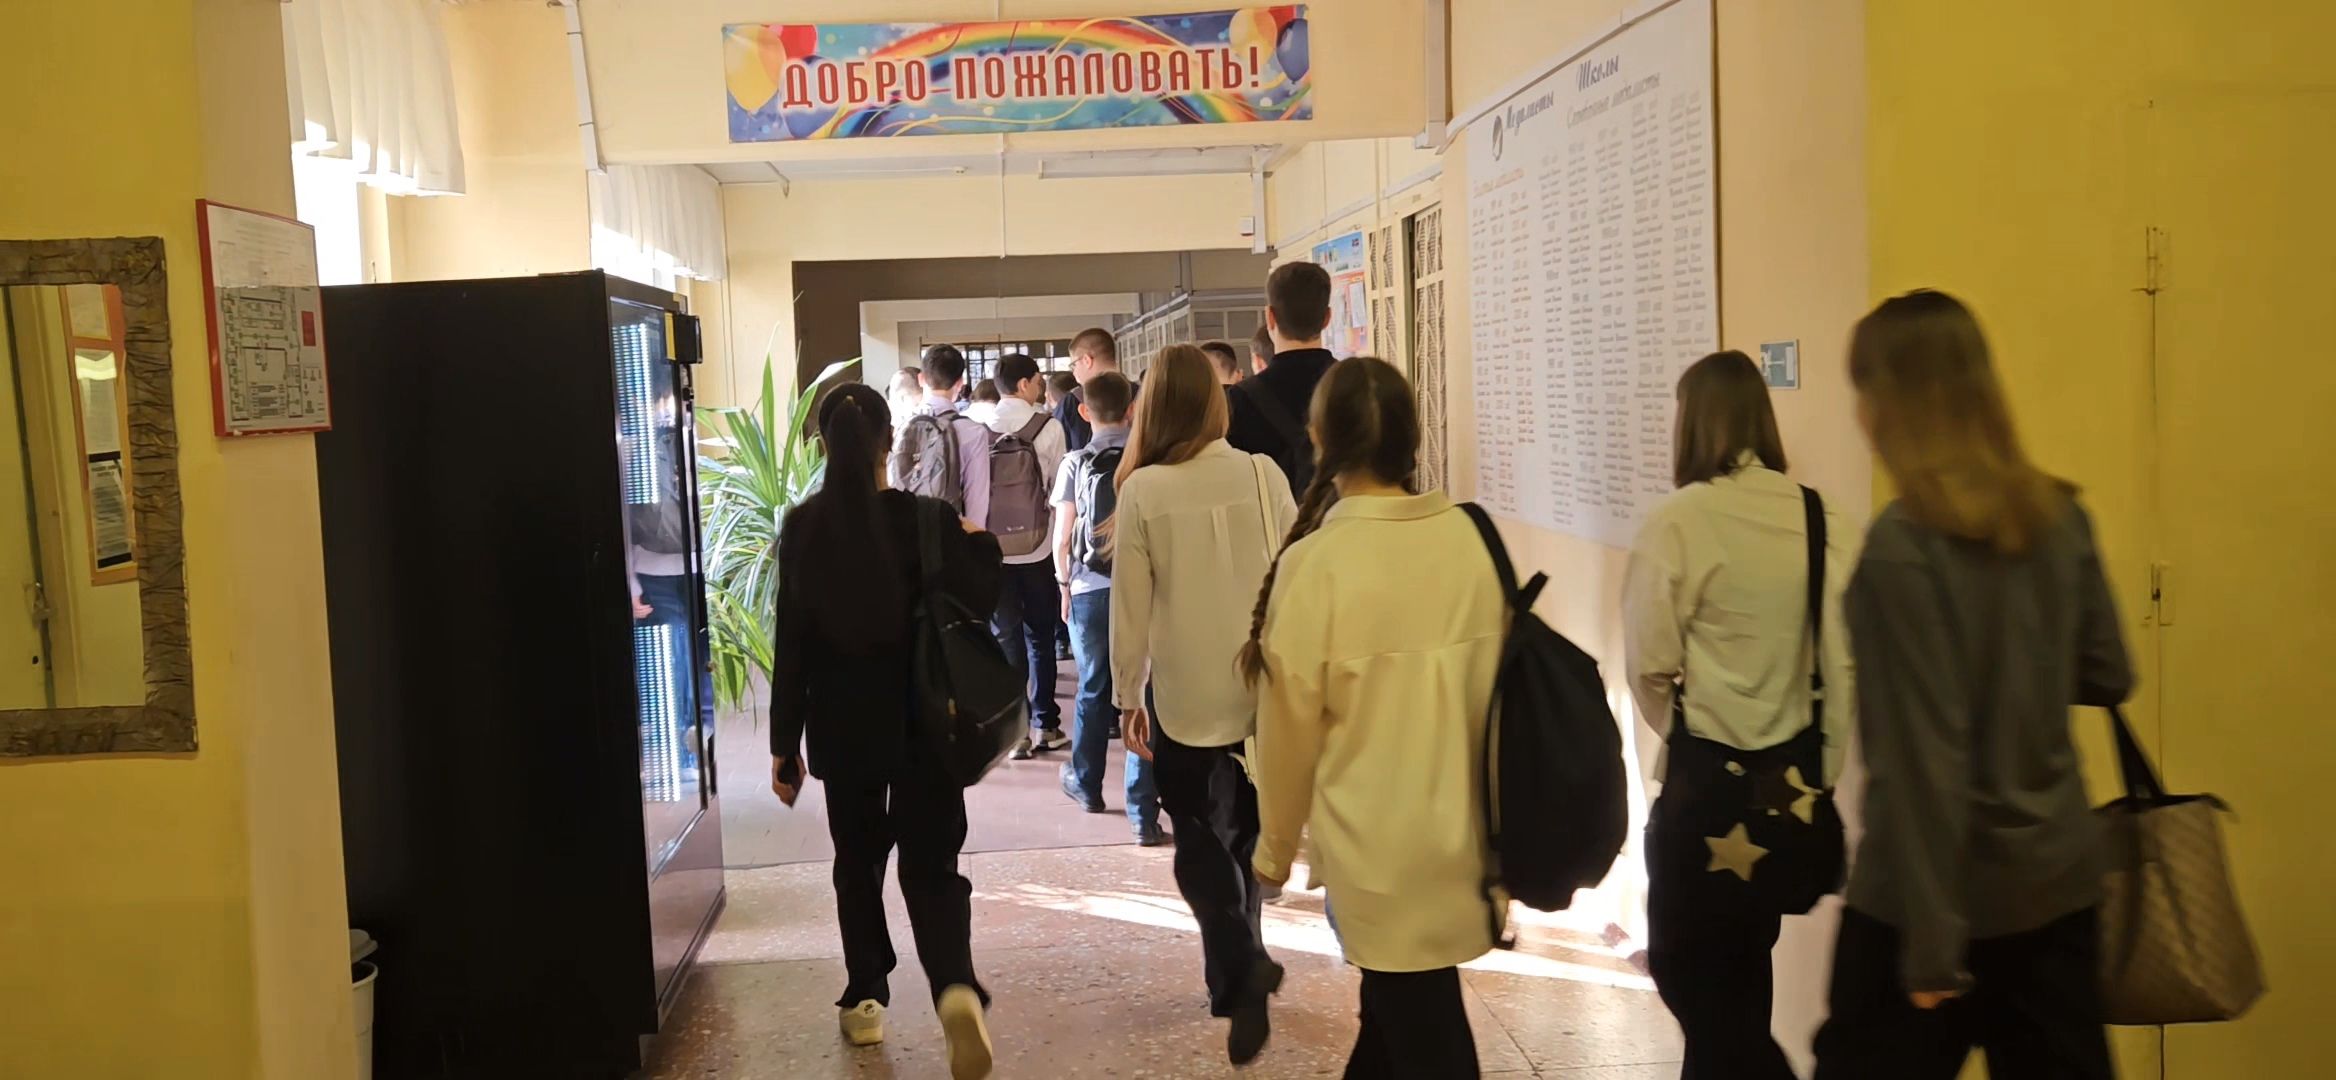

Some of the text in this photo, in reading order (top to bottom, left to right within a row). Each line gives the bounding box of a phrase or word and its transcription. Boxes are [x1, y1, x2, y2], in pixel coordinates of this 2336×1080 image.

[783, 46, 1259, 108] ДОБРО ПОЖАЛОВАТЬ!
[1576, 54, 1619, 92] Школы
